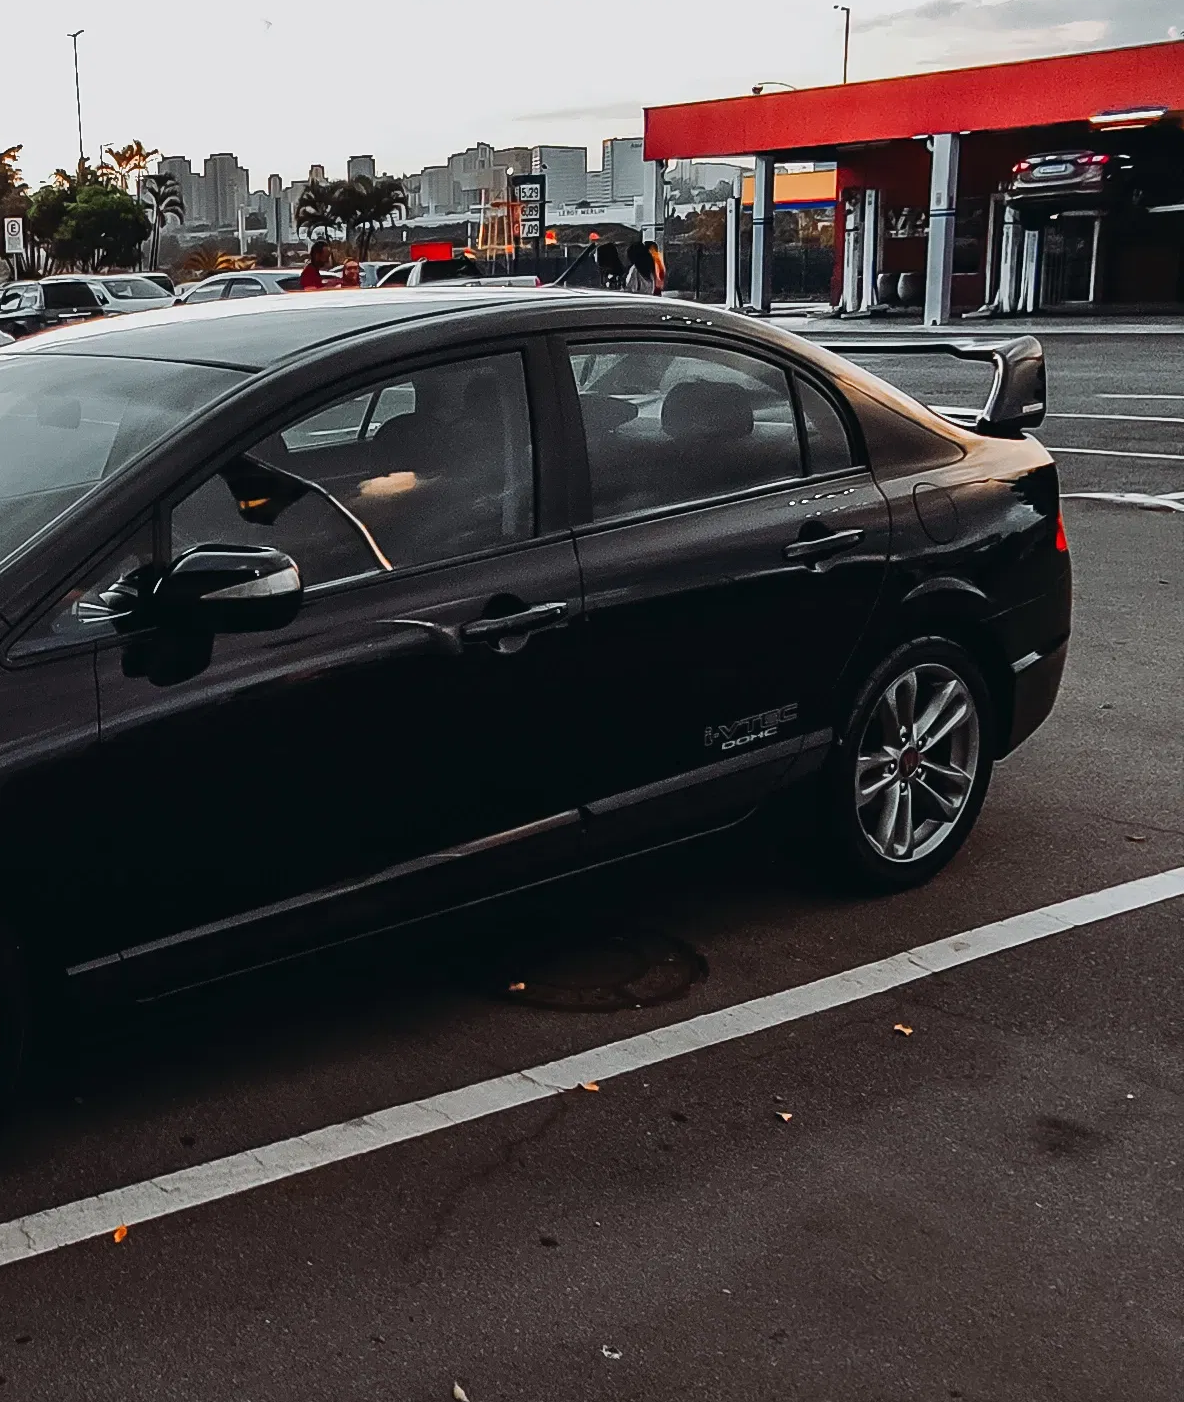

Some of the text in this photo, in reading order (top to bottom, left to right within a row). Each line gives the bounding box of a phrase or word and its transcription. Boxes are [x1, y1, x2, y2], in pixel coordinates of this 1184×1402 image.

[11, 224, 17, 233] E
[704, 702, 798, 747] i-VTEC
[721, 726, 778, 750] DOHC
